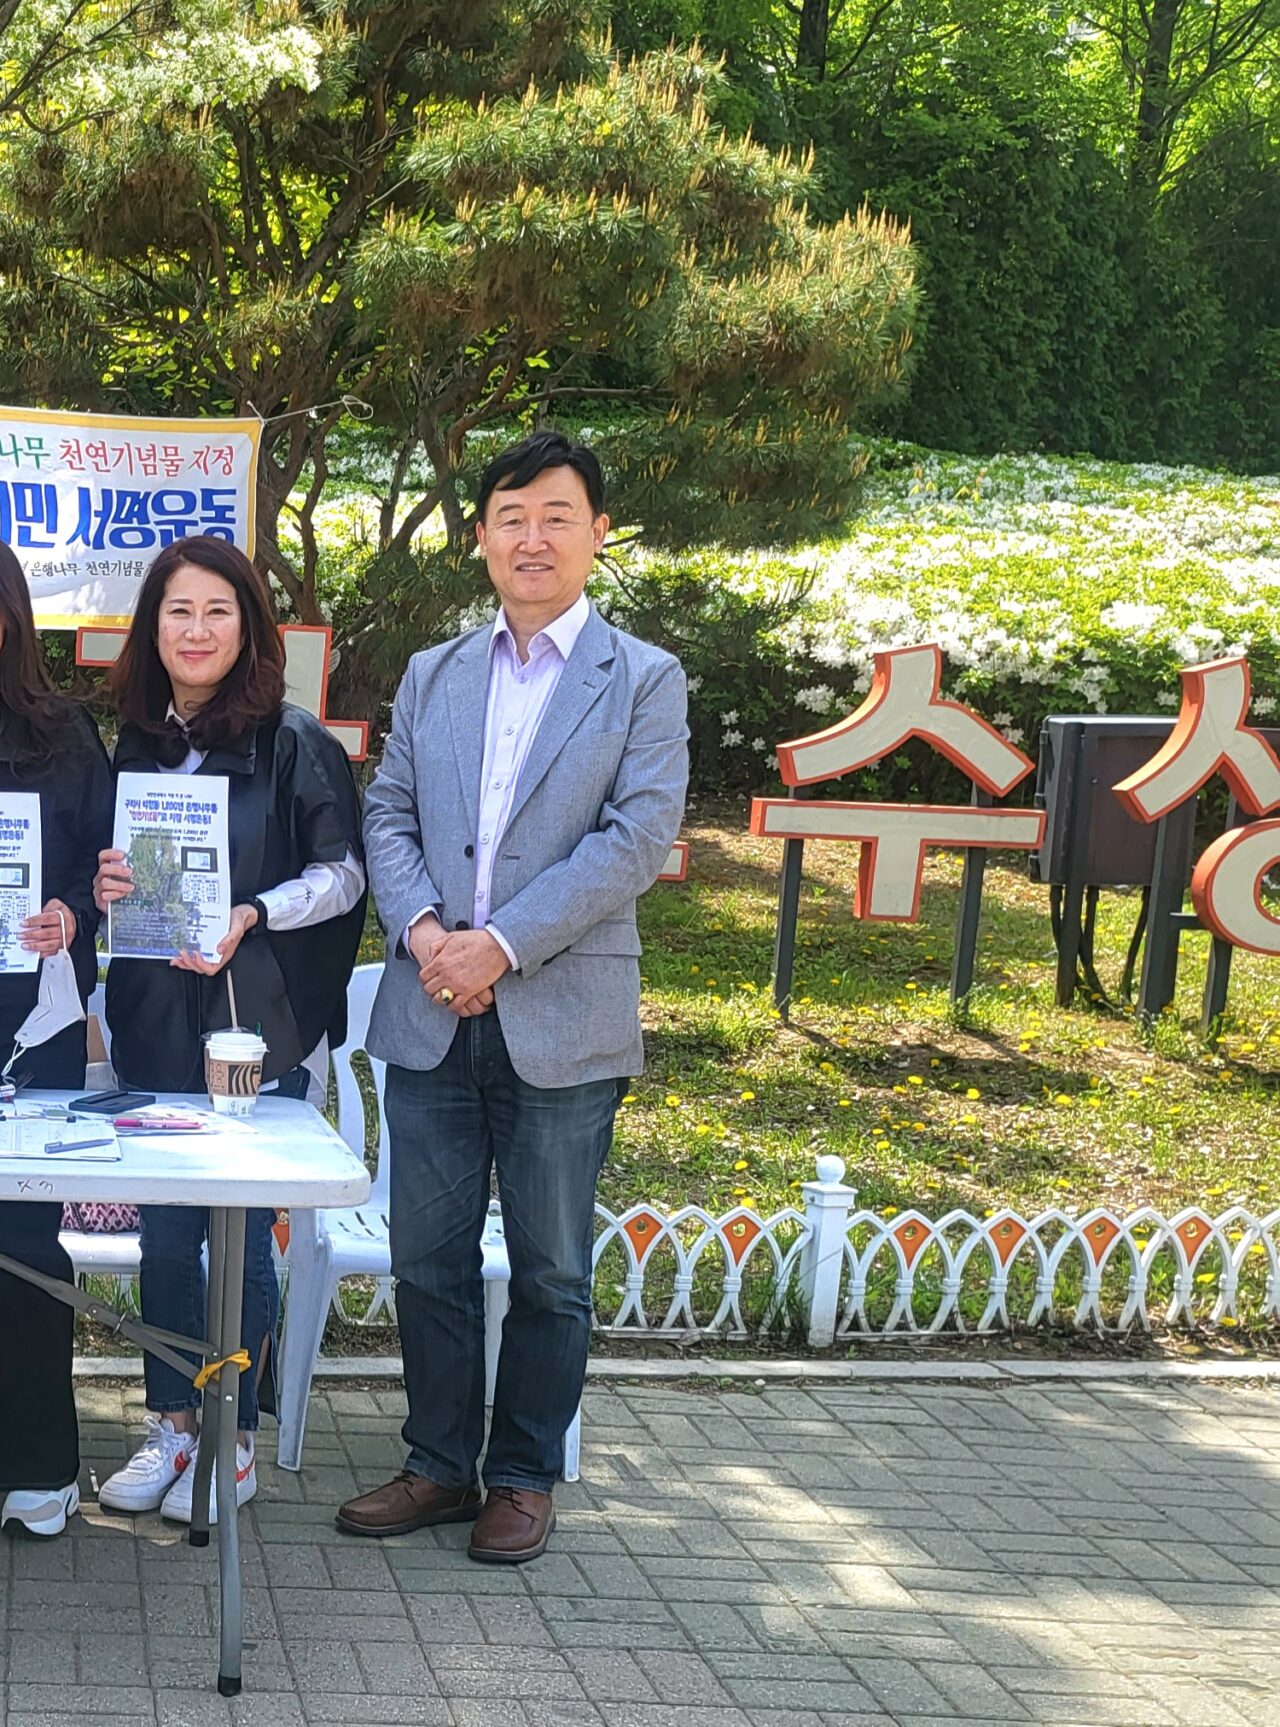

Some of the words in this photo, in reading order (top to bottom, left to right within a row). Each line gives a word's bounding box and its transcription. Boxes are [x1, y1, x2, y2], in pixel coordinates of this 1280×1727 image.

[59, 438, 184, 477] 천연기념물
[188, 445, 235, 476] 지정
[66, 486, 237, 550] 서명운동
[30, 560, 81, 577] 은행나무
[86, 559, 144, 577] 천연기념물
